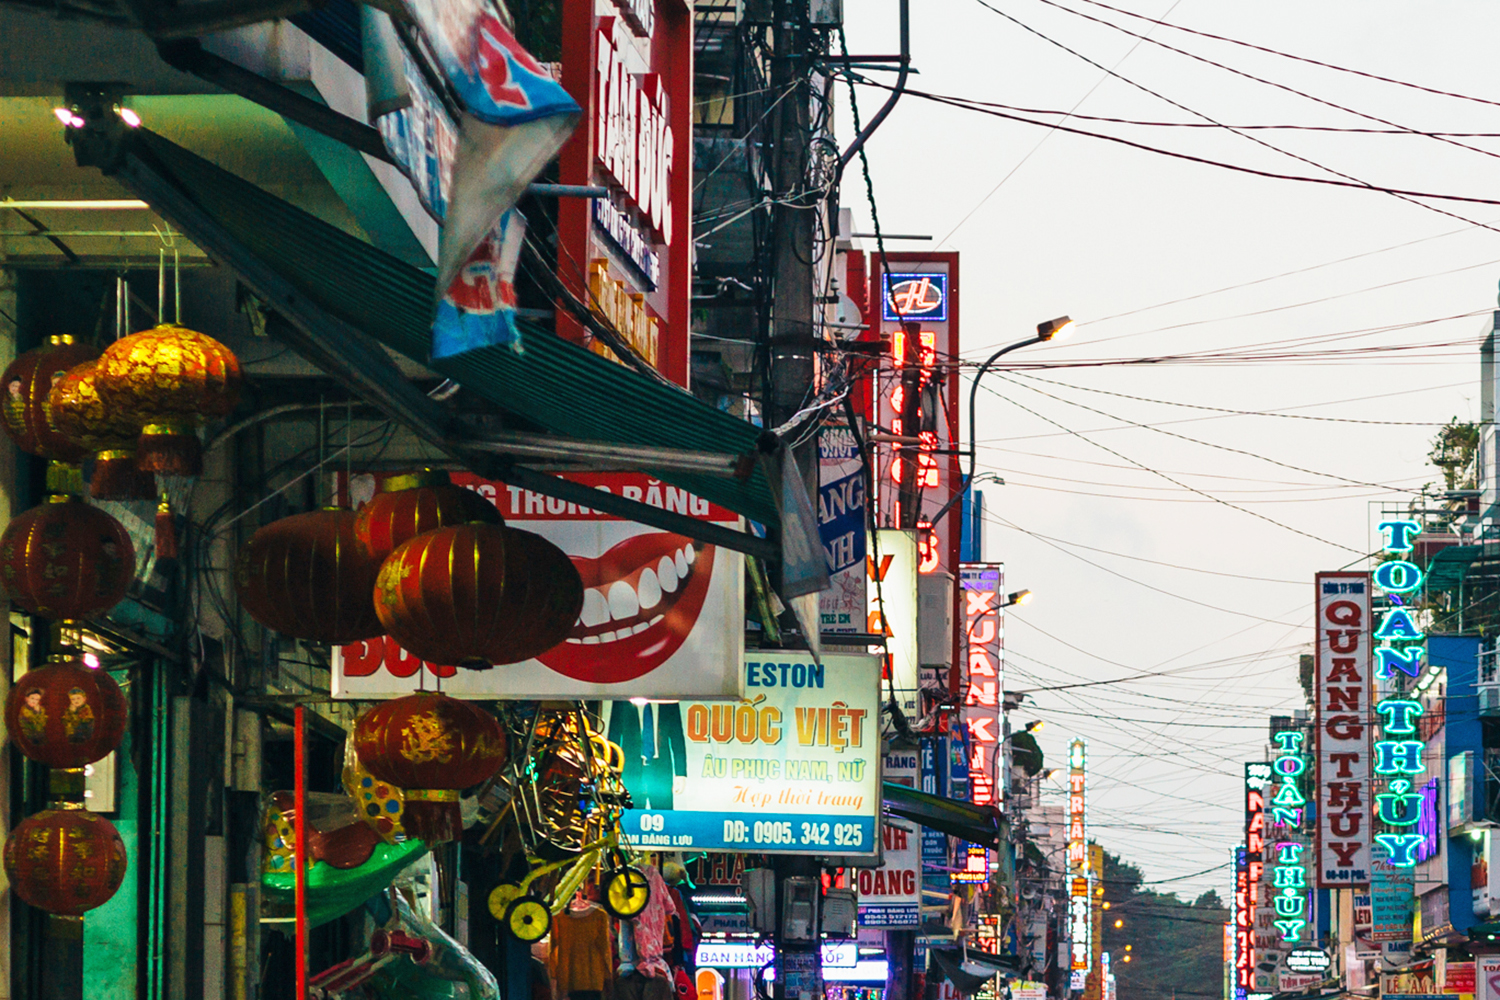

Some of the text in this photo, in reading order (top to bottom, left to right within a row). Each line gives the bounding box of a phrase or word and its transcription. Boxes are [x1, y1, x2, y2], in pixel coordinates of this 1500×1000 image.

[1373, 519, 1425, 680] TOÀN
[744, 662, 824, 688] ESTON
[1325, 600, 1364, 740] QUANG
[687, 694, 783, 745] QUỐC
[794, 701, 867, 754] VIỆT
[702, 754, 866, 784] ÂU PHỤC NAM, NỮ
[817, 791, 863, 810] trang
[640, 813, 664, 832] 09
[754, 821, 796, 845] 0905.
[801, 822, 830, 846] 342
[833, 823, 862, 846] 925
